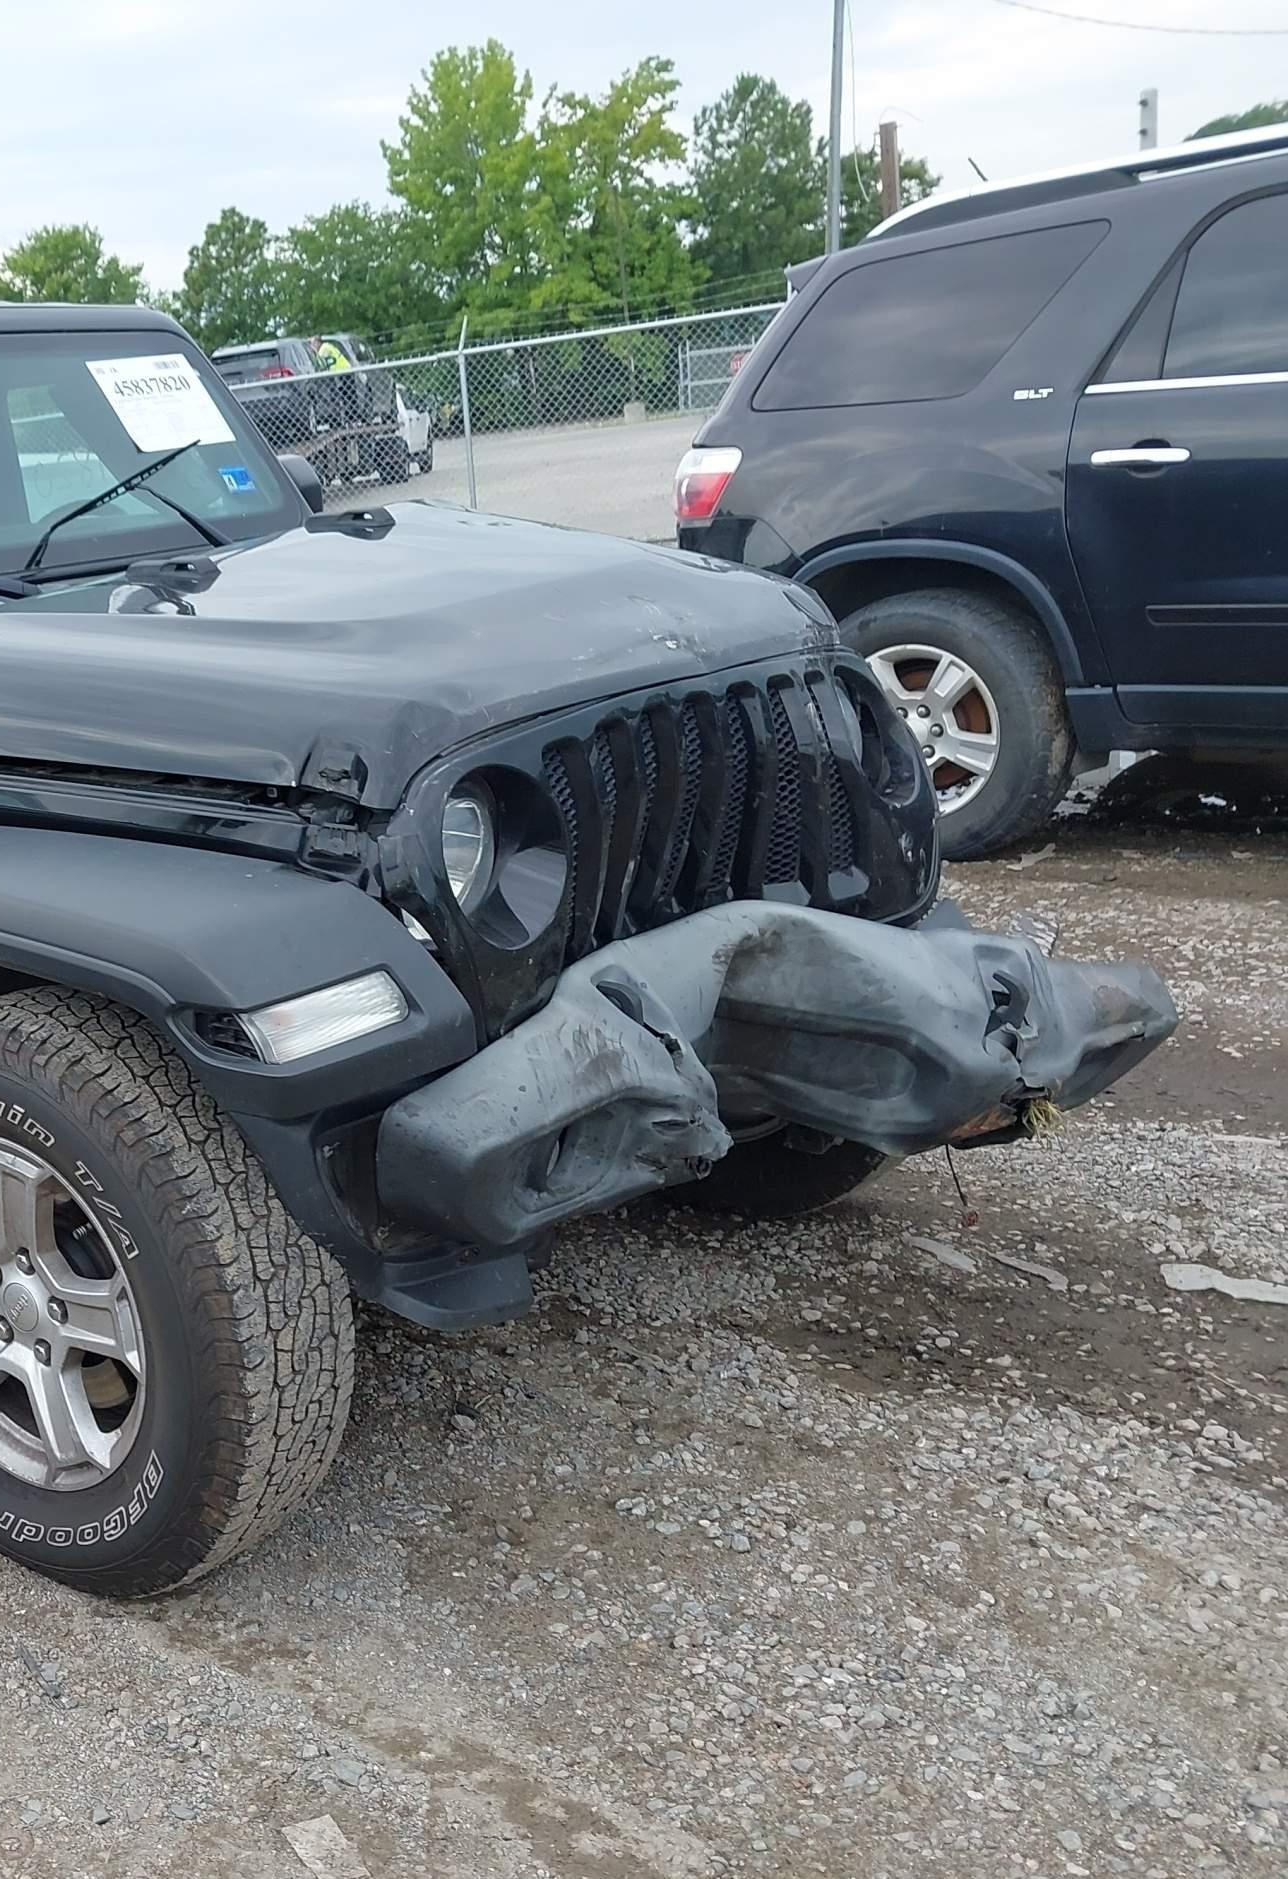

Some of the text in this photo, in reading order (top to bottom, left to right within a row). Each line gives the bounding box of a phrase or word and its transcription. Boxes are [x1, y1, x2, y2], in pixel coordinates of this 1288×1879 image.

[114, 375, 191, 397] 45837820
[1013, 387, 1054, 400] SLT
[72, 1160, 140, 1260] T/A
